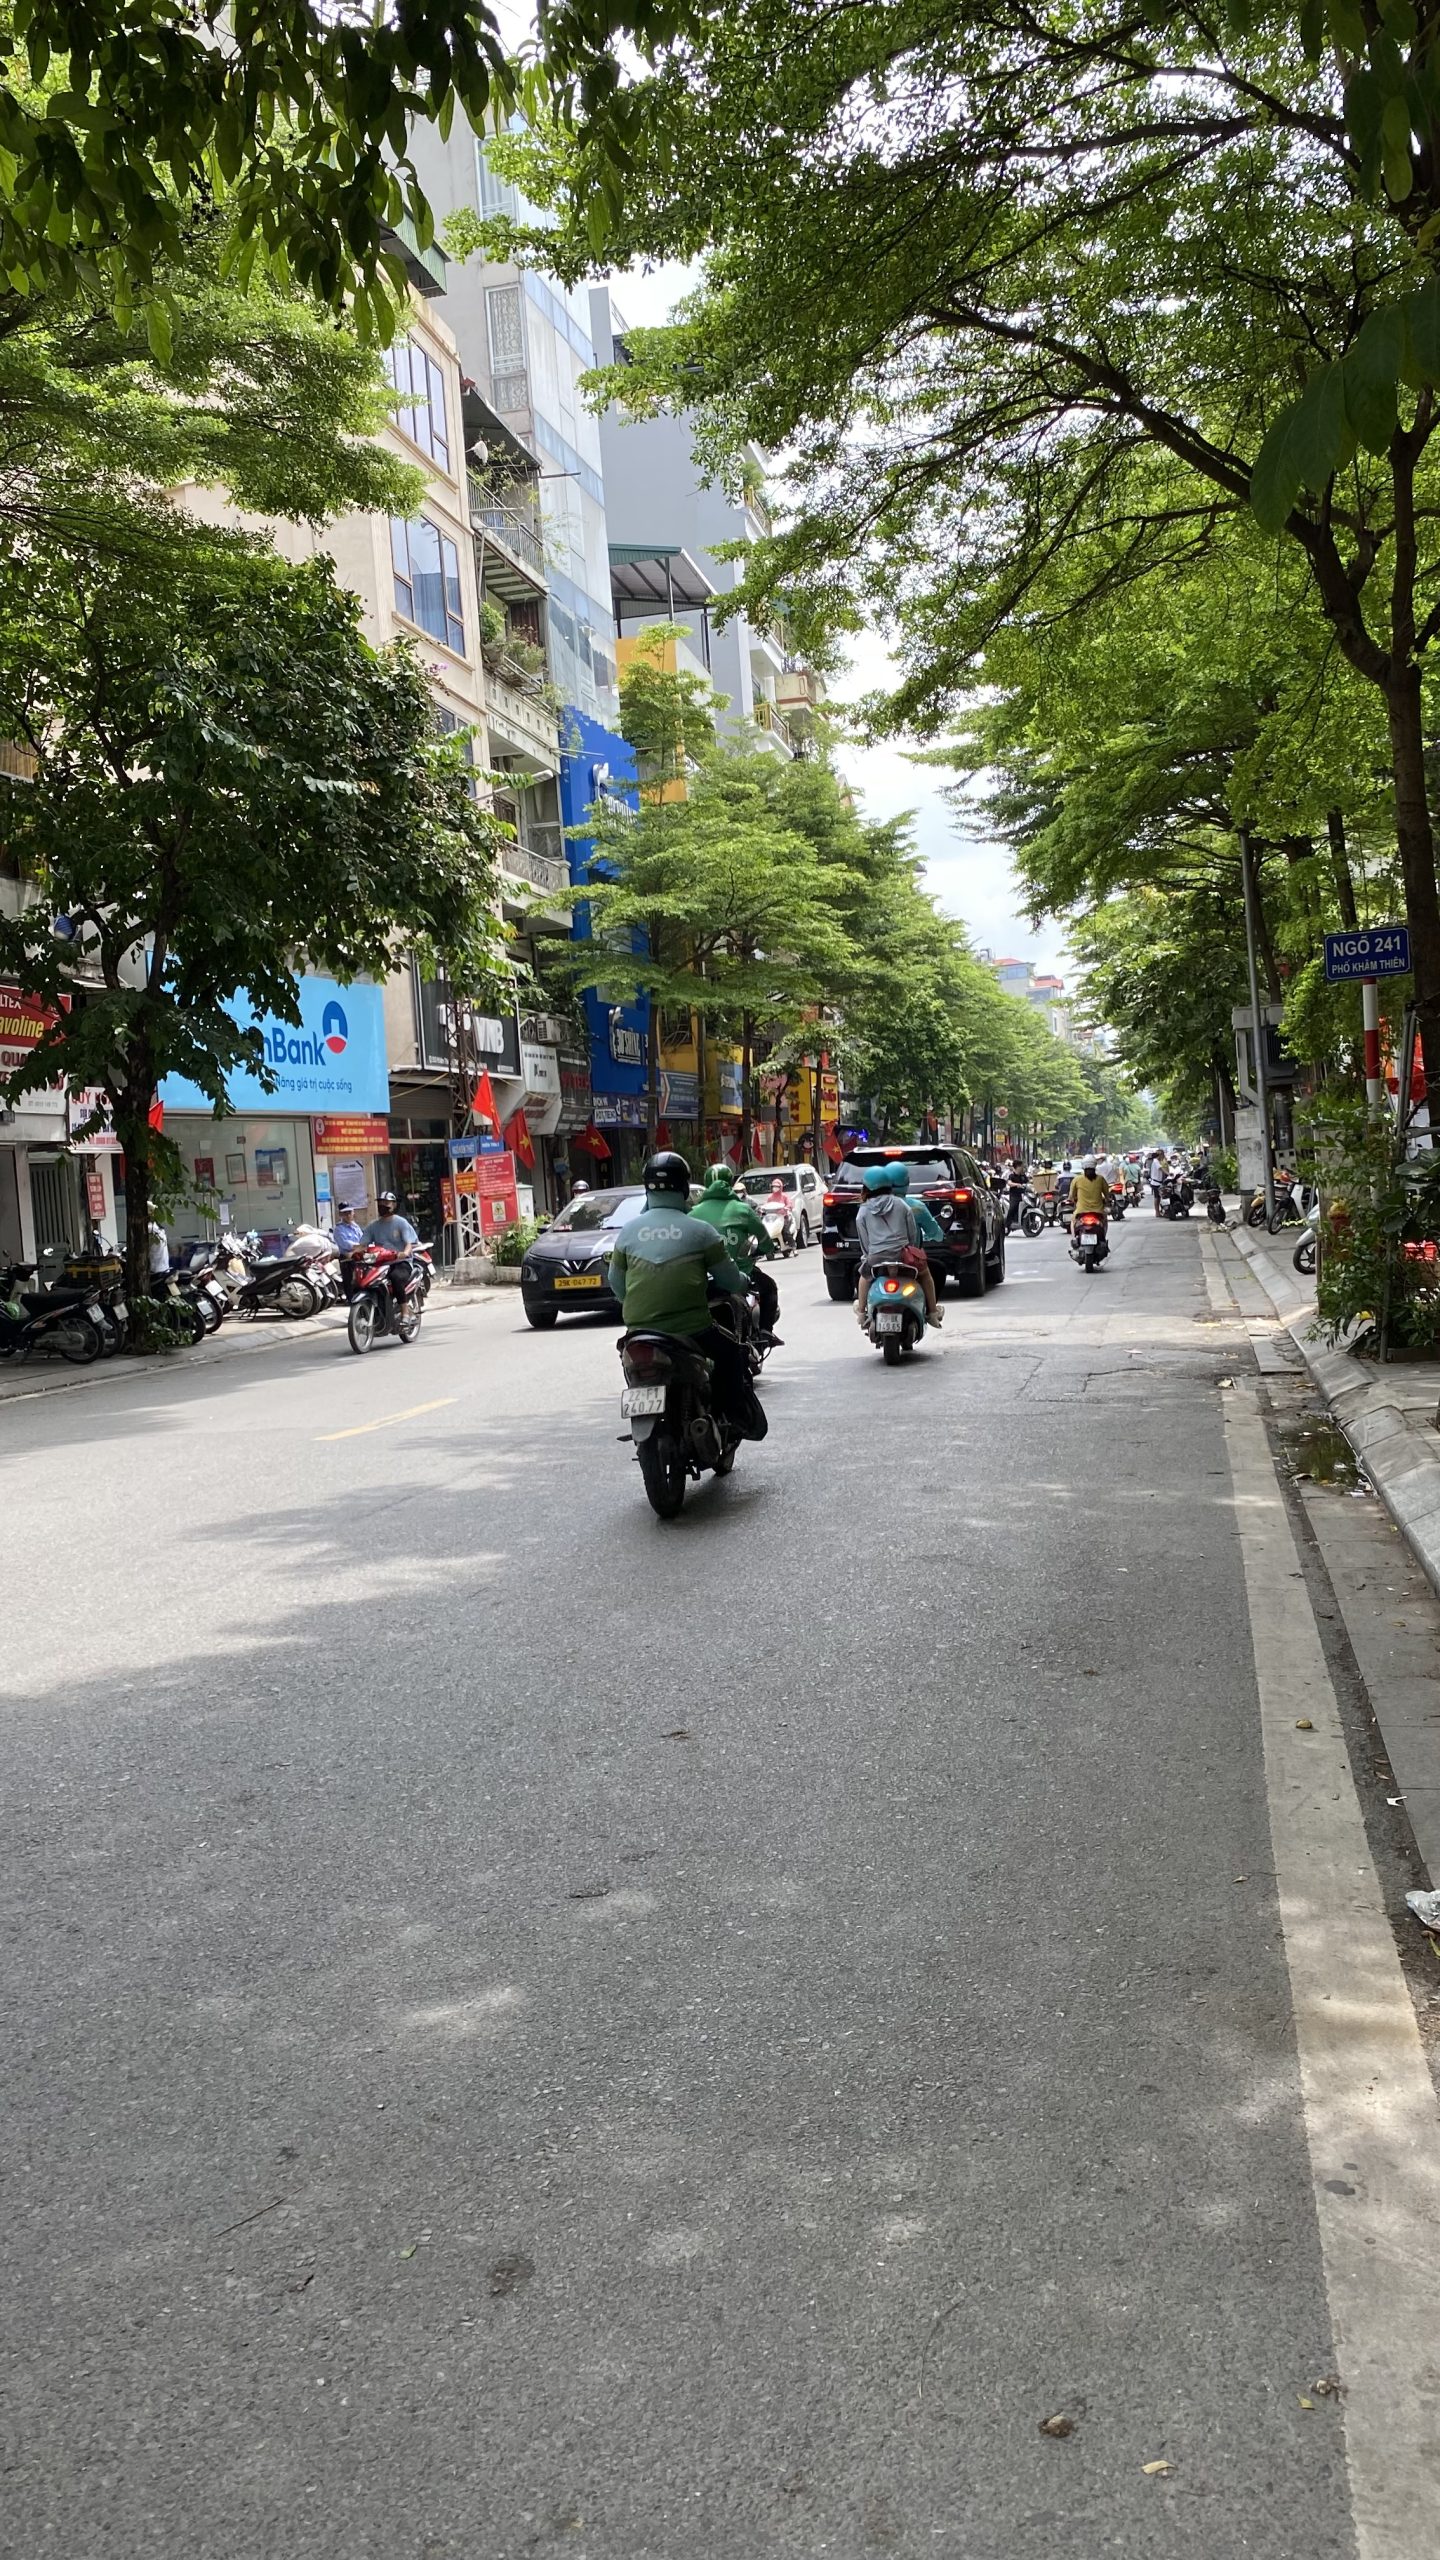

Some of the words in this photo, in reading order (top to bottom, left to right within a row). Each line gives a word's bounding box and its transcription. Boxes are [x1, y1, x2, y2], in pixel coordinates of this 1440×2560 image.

[1333, 935, 1370, 958] NGÕ
[1374, 935, 1401, 953] 241
[1331, 959, 1351, 974] PHỐ
[1352, 959, 1378, 973] KHÂM
[1379, 956, 1405, 970] THIÊN
[263, 1027, 326, 1066] nBank
[318, 1080, 335, 1093] cuộc
[336, 1078, 352, 1094] sống
[637, 1224, 683, 1242] Grab
[720, 1228, 739, 1246] ab
